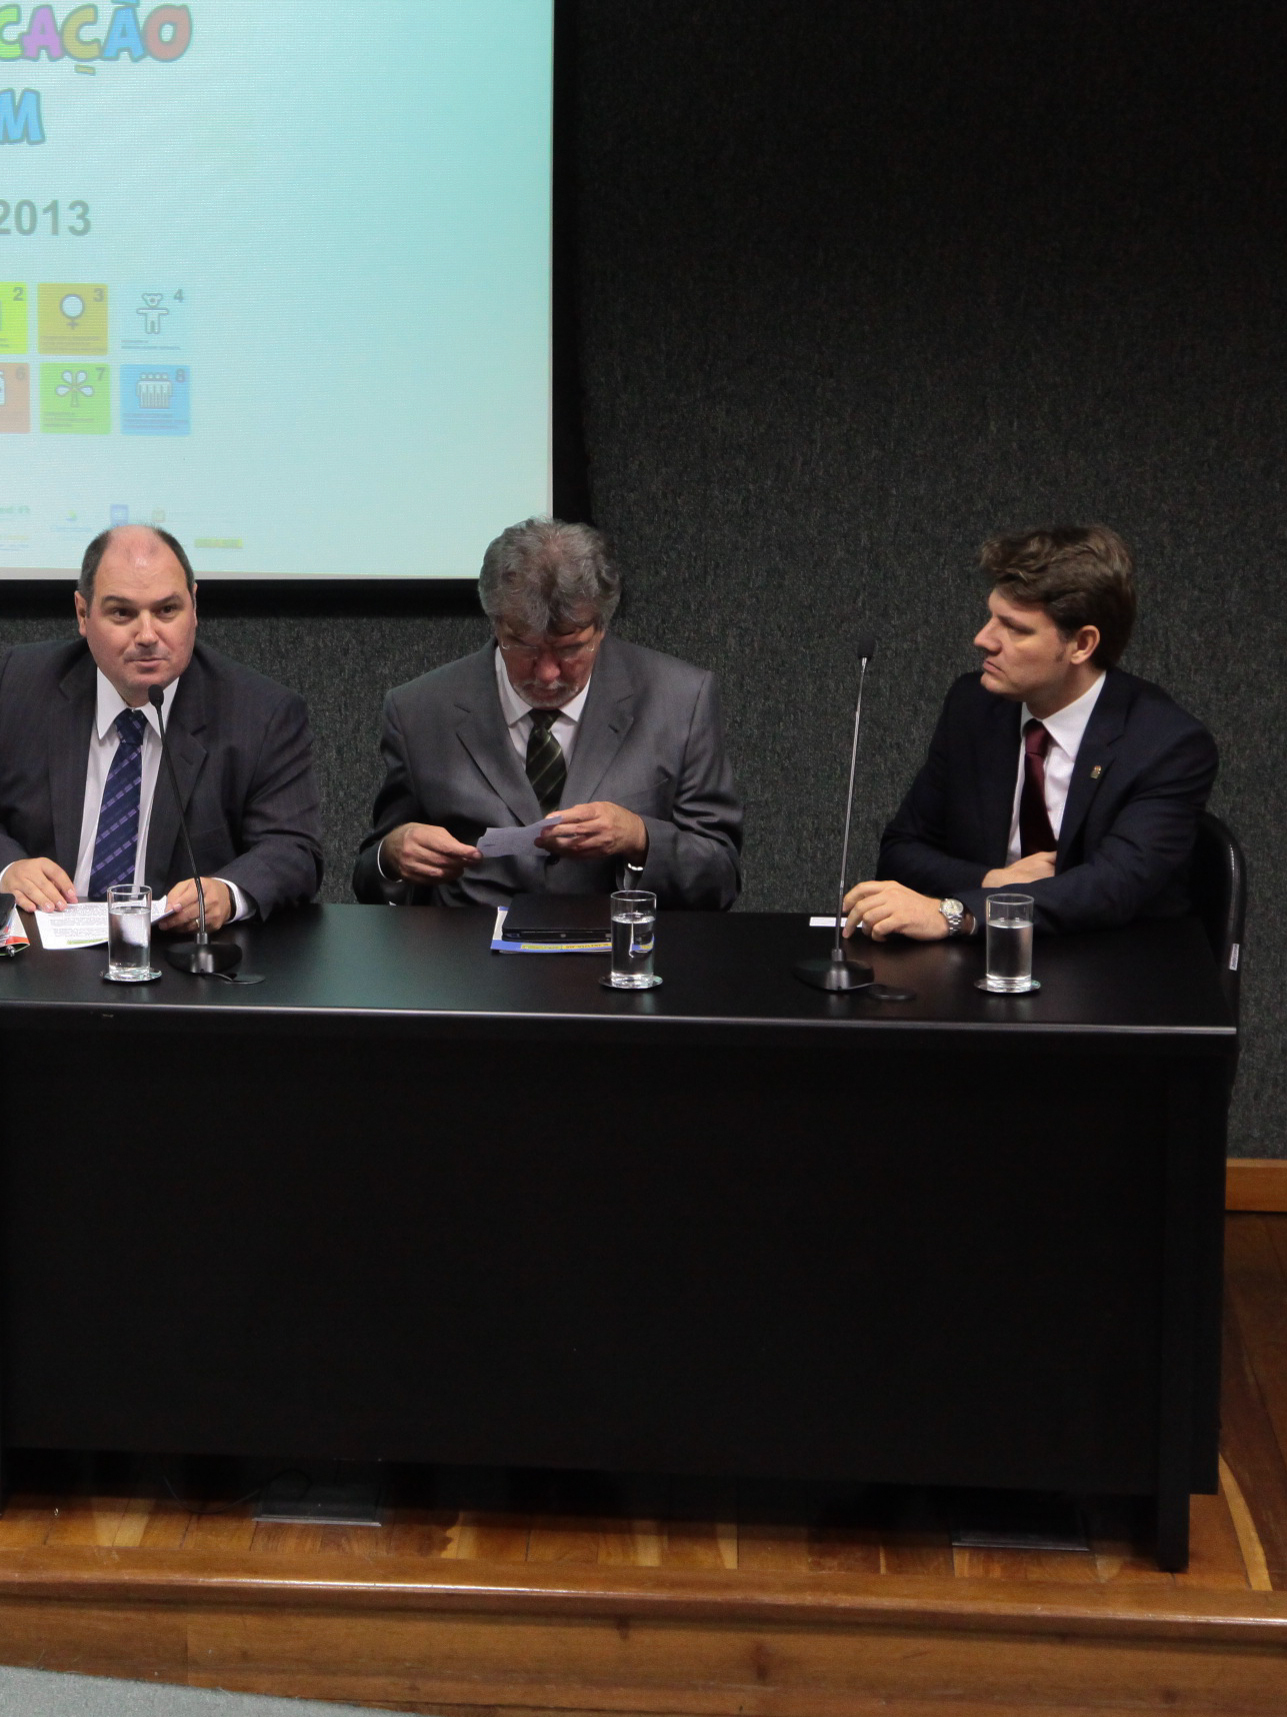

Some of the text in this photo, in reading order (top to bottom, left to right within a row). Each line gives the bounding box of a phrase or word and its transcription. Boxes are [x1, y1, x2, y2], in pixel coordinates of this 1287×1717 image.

[13, 286, 24, 301] 2
[93, 288, 104, 302] 3
[173, 288, 184, 303] 4
[15, 366, 25, 381] 6
[95, 367, 105, 381] 7
[175, 368, 186, 383] 8
